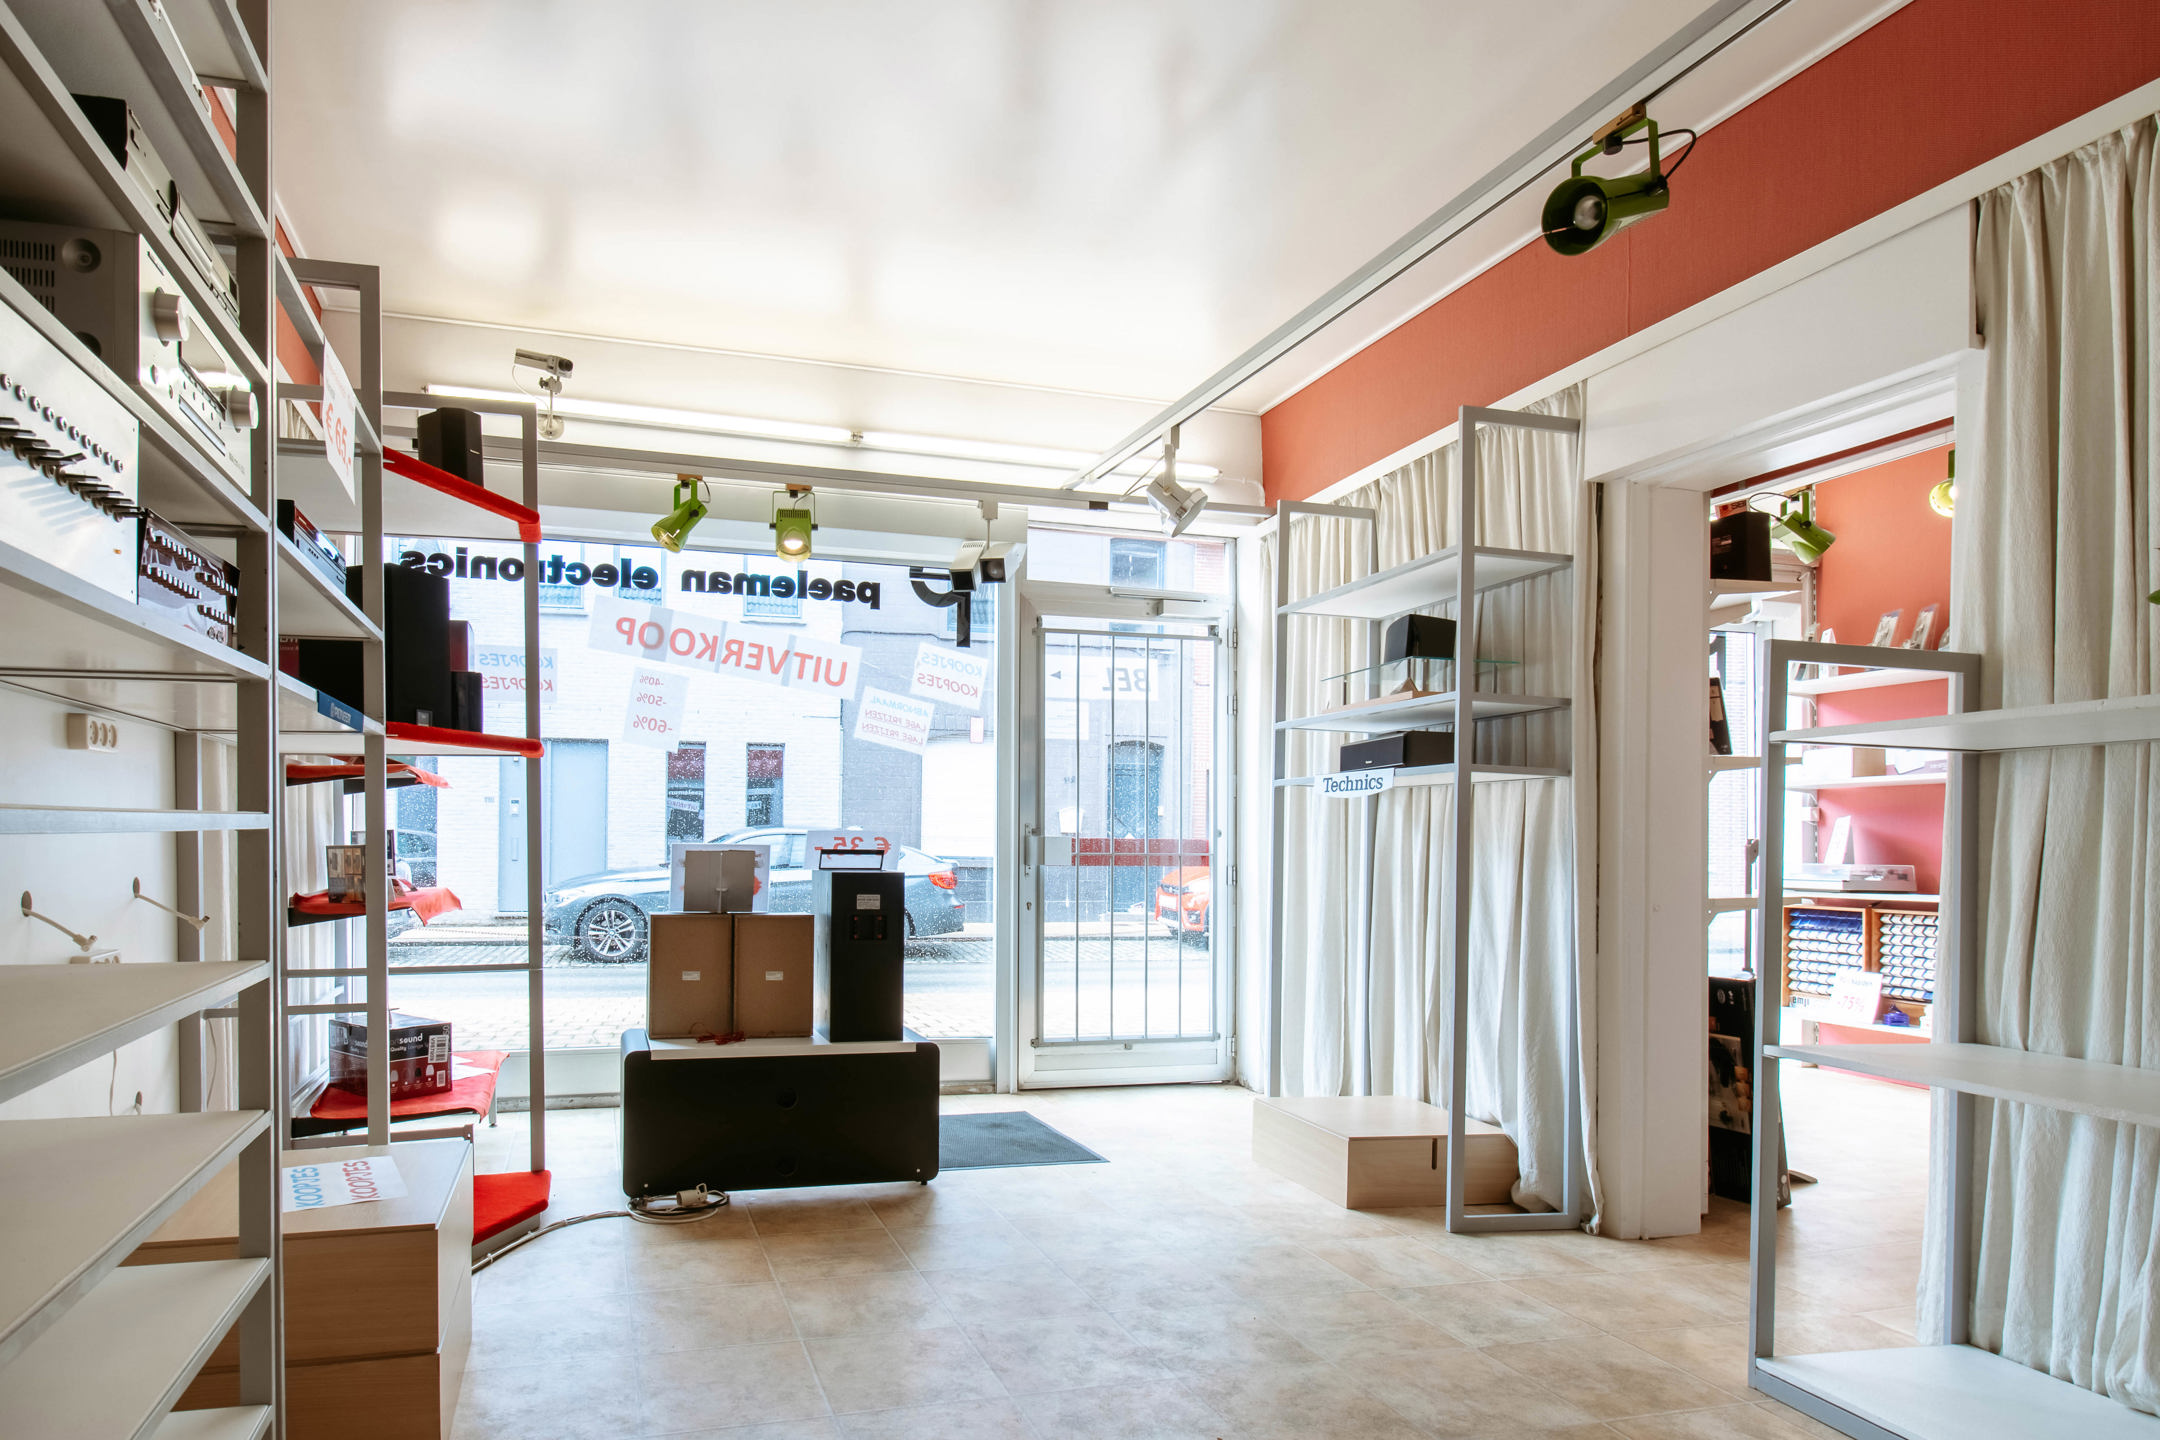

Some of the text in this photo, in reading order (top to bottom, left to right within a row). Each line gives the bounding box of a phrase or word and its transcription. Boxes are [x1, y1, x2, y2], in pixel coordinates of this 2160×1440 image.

[1323, 773, 1384, 793] Technics
[290, 1166, 326, 1209] KOOPJES
[342, 1160, 382, 1201] KOOPJES
